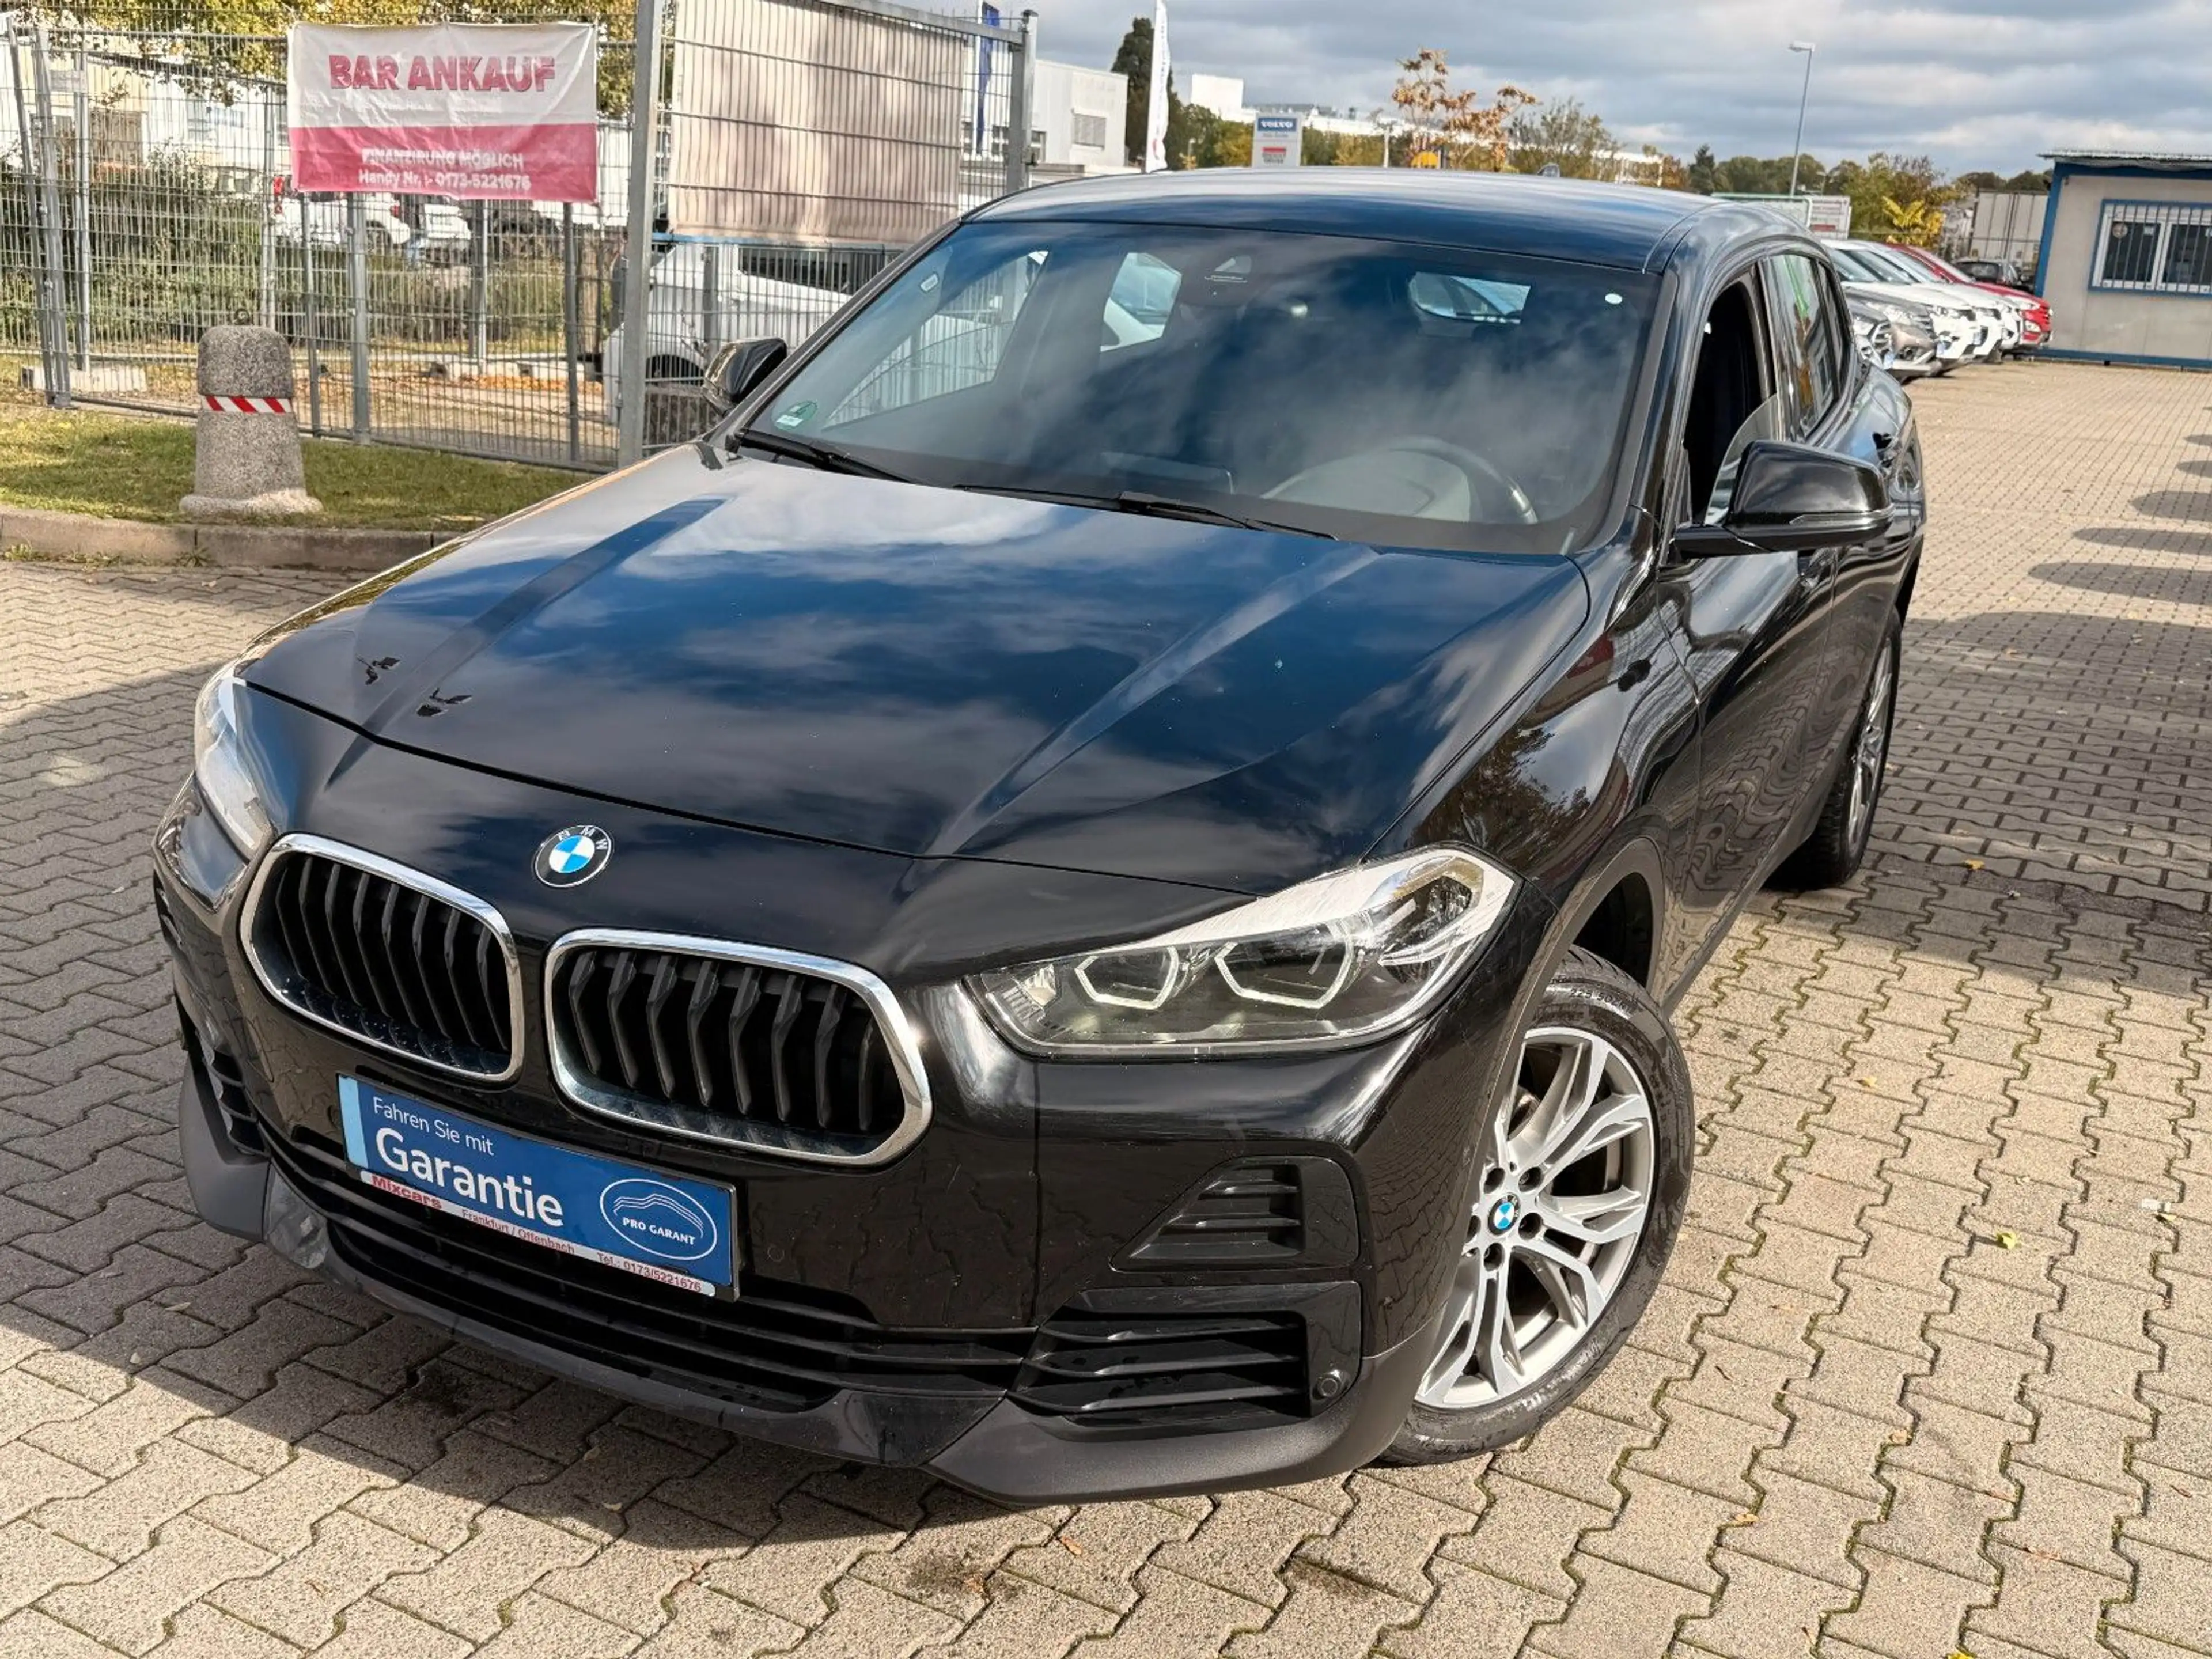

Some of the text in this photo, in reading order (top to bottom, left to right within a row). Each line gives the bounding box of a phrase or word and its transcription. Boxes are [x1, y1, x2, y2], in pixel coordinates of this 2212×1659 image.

[329, 55, 555, 92] BAR ANKAUF
[459, 148, 524, 172] MÖGLICH
[358, 168, 400, 190] Handy
[373, 1096, 494, 1156] Fahren Sie mit
[376, 1127, 564, 1228] Garantie
[372, 1174, 442, 1210] Mixcars
[623, 1260, 702, 1292] 0173/5221676
[622, 1217, 696, 1245] PRO GARANT
